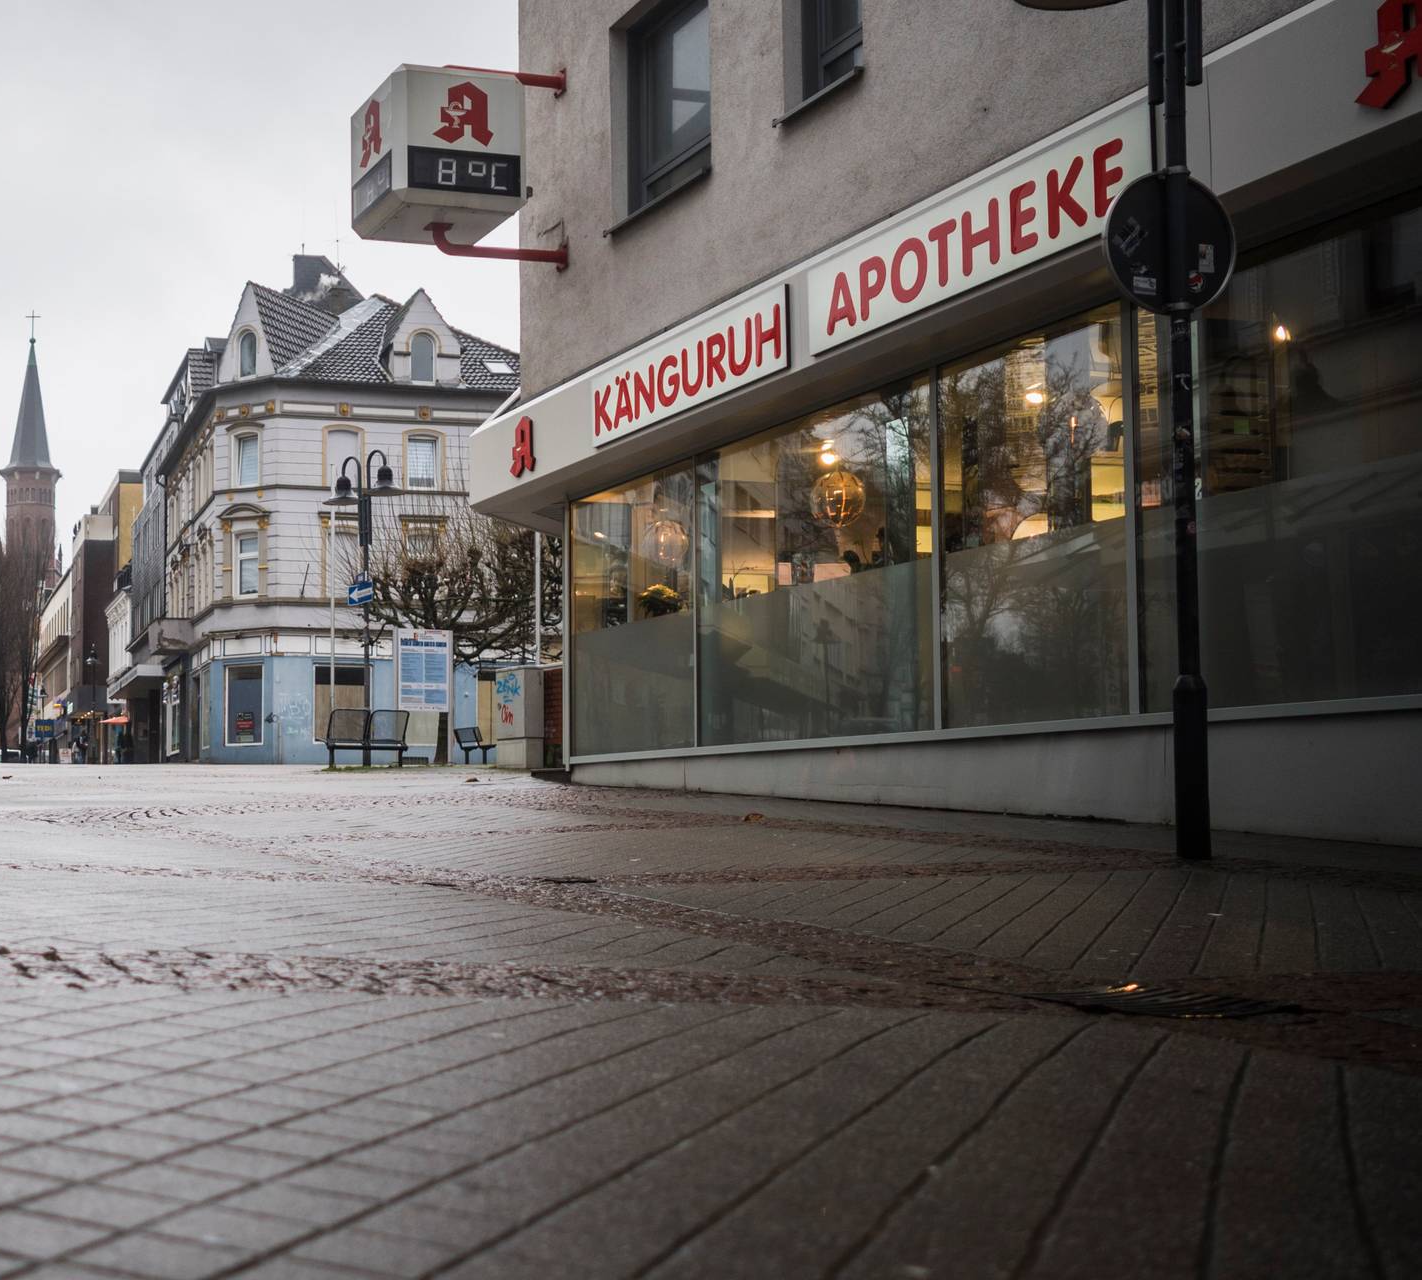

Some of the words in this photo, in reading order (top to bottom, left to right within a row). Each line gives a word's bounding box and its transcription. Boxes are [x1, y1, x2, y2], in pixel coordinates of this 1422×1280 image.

[360, 99, 382, 168] A
[433, 81, 494, 147] A
[594, 303, 782, 437] KÄNGURUH
[827, 138, 1124, 337] APOTHEKE
[509, 416, 537, 478] A
